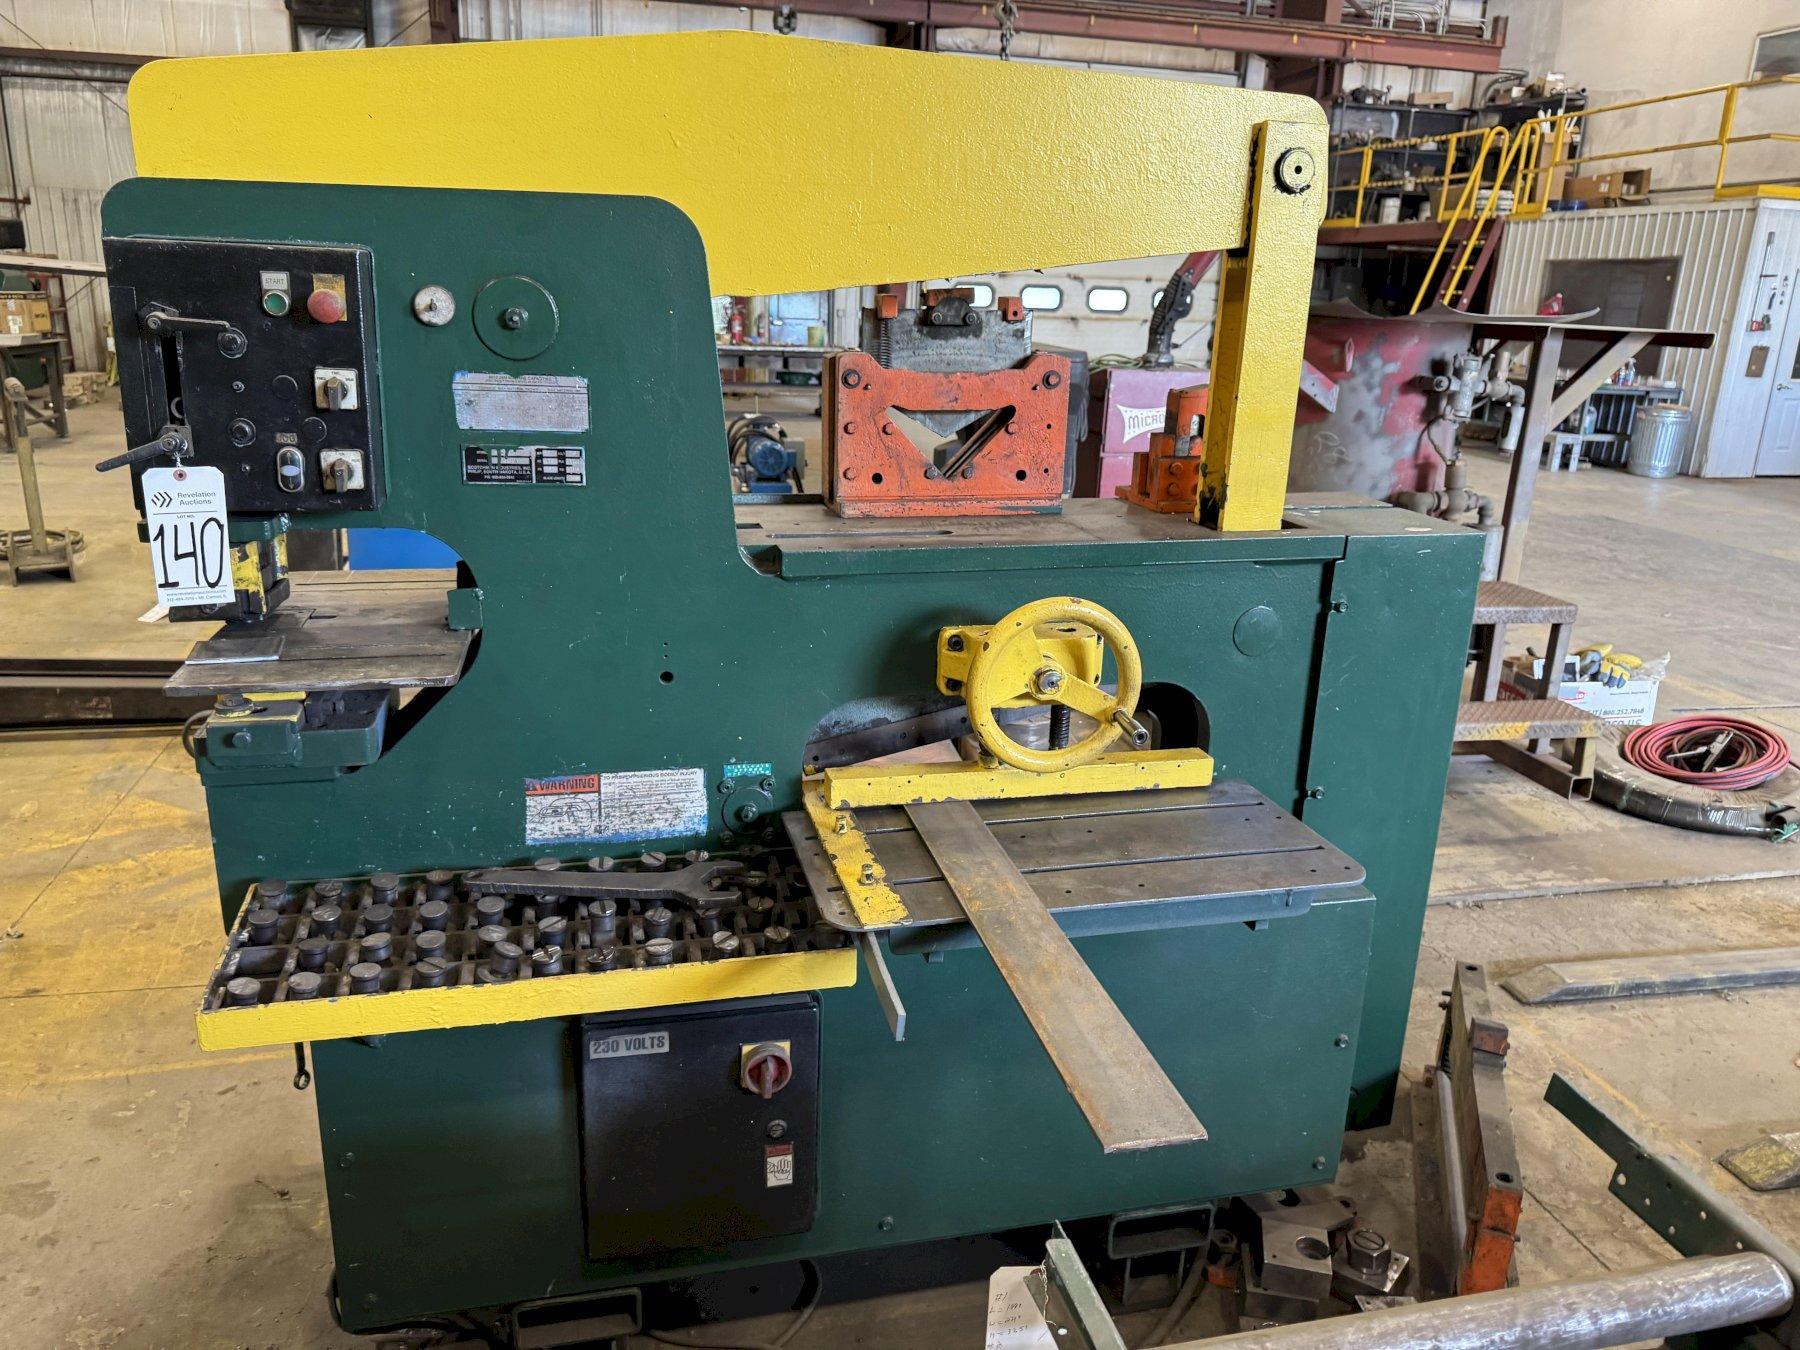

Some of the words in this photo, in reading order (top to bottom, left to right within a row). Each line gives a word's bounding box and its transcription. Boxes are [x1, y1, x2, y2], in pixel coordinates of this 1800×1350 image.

[152, 517, 225, 588] 140
[539, 777, 595, 791] WARNING
[593, 1040, 620, 1054] 230
[624, 1035, 665, 1051] VOLTS
